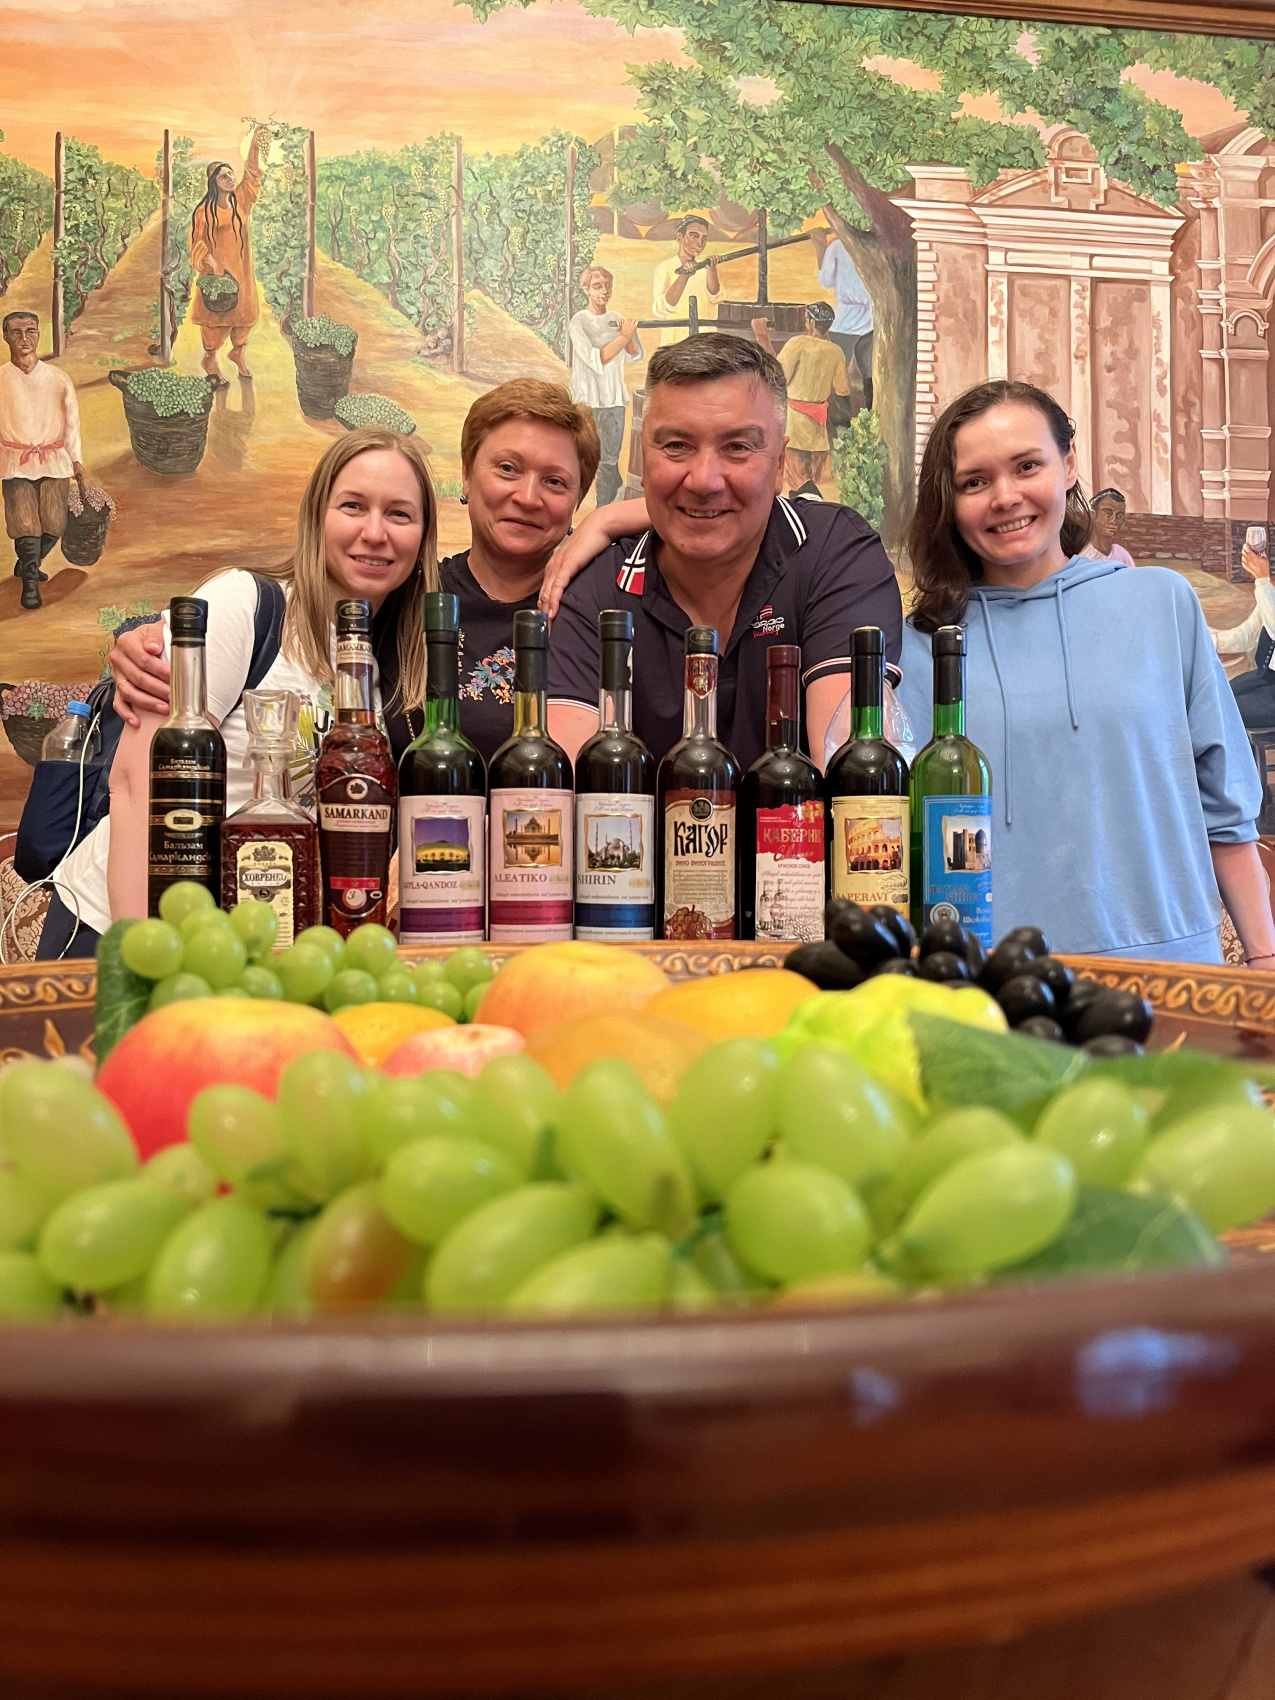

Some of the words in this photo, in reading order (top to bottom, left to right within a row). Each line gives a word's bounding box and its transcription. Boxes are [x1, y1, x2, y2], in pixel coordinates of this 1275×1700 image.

[763, 623, 785, 633] Norge
[324, 806, 388, 820] SAMARKAND
[163, 840, 204, 850] Бальзам
[244, 873, 287, 882] ХОВРЕНКО
[493, 873, 548, 883] ALEATIKO
[577, 874, 617, 885] SHIRIN
[347, 890, 356, 900] 3
